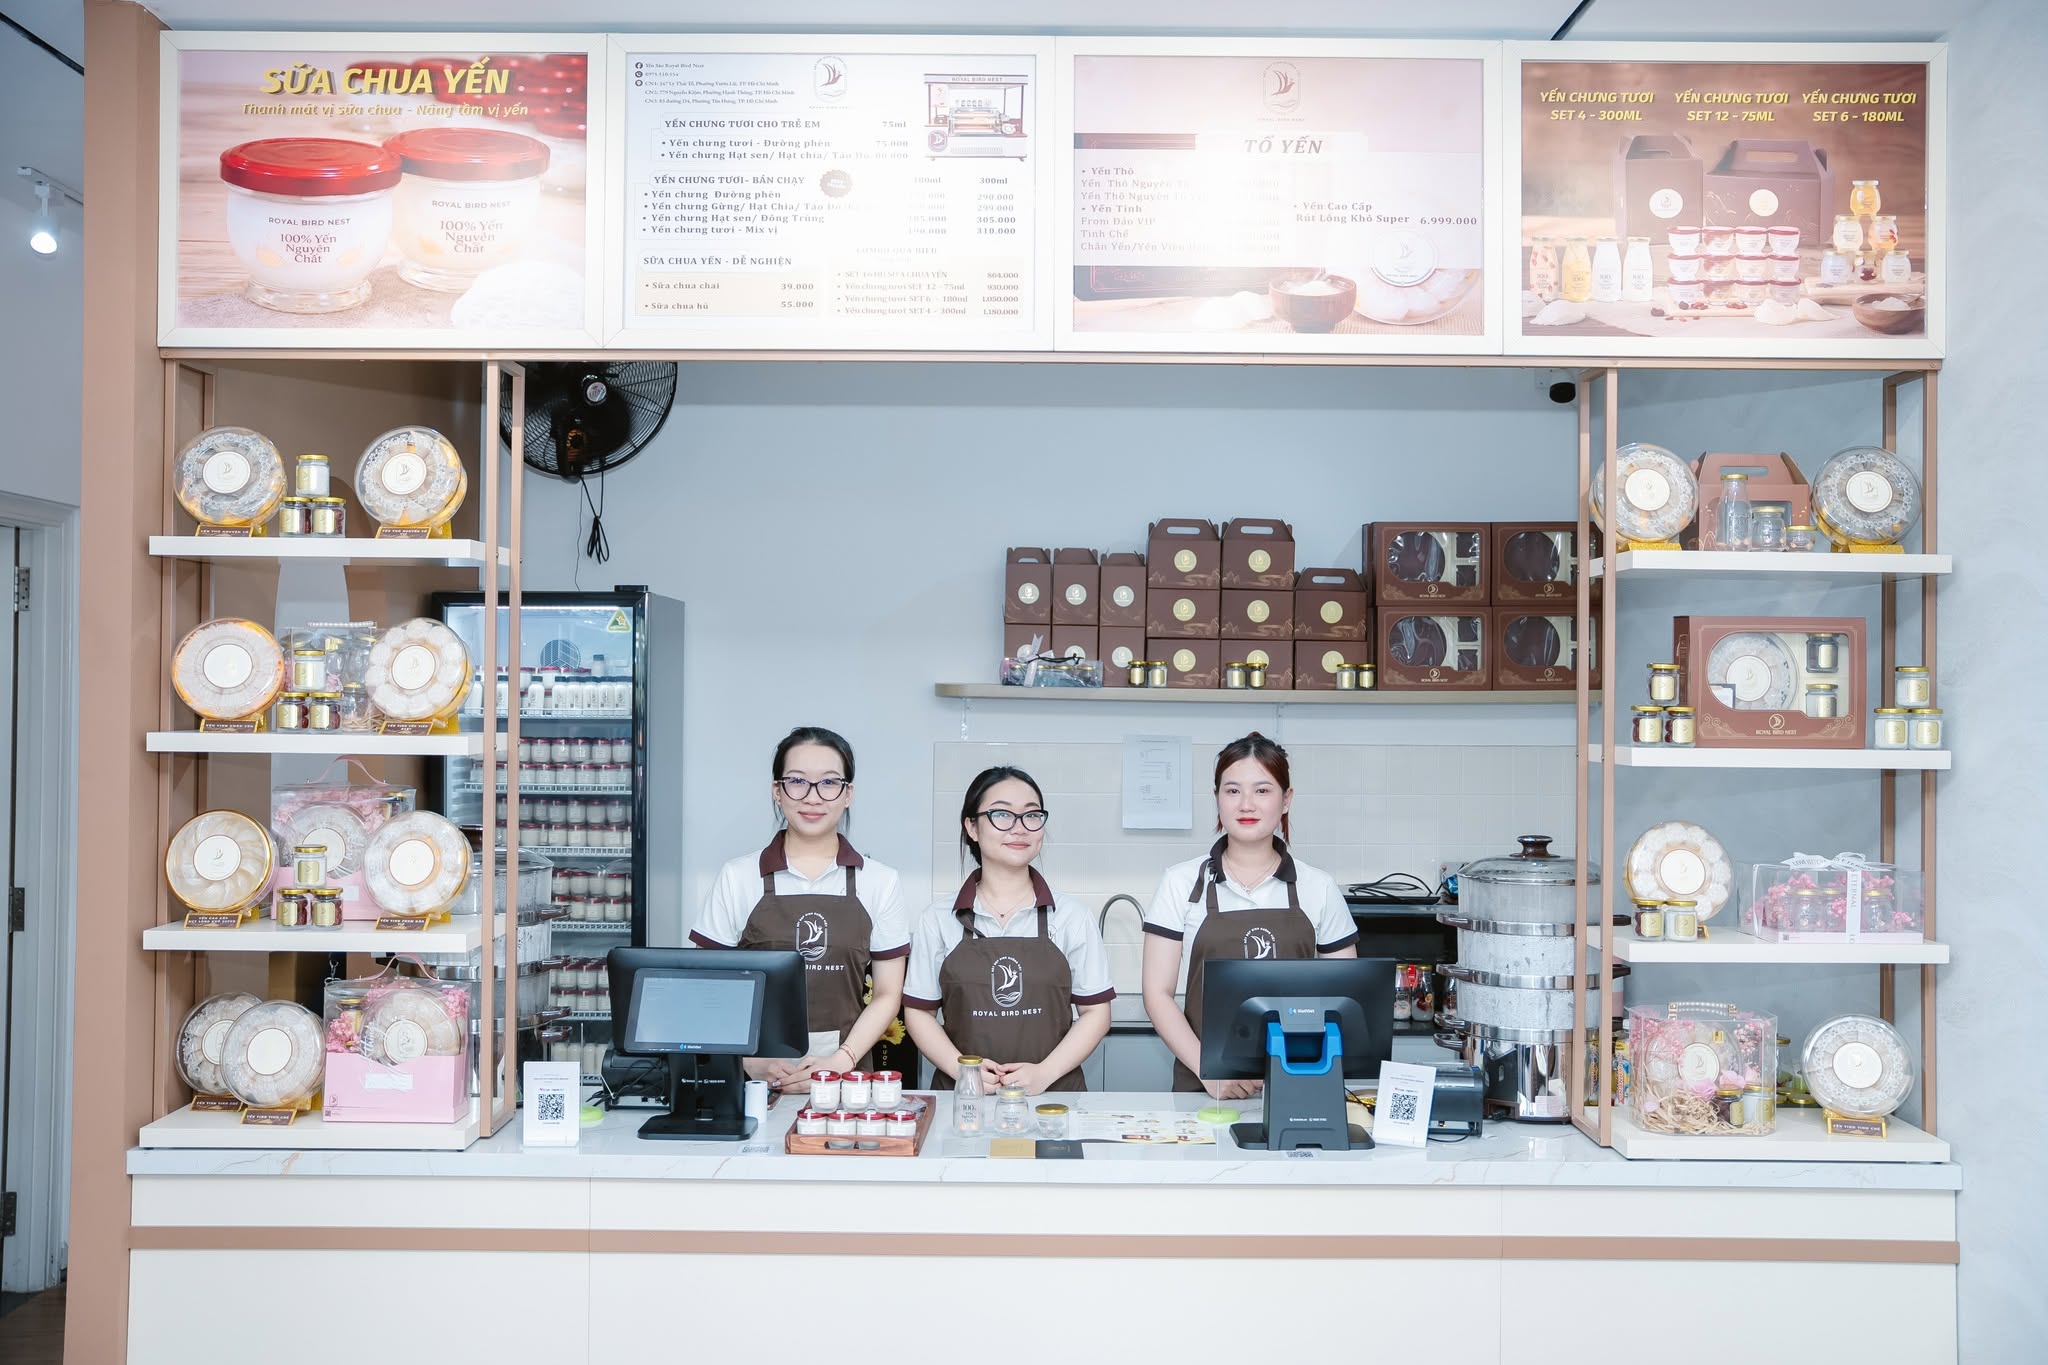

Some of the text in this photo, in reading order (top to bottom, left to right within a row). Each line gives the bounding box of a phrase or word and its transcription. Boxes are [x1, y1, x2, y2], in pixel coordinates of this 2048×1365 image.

[260, 56, 511, 95] SỮA CHUA YẾN
[1539, 87, 1655, 103] YẾN CHƯNG TƯƠI
[1674, 88, 1789, 104] YẾN CHƯNG TƯƠI
[1801, 88, 1917, 104] YẾN CHƯNG TƯƠI
[243, 103, 287, 116] Thanh
[290, 103, 318, 116] mát
[322, 103, 335, 118] vị
[367, 103, 403, 116] chua
[457, 101, 484, 116] tầm
[488, 103, 500, 118] vị
[503, 101, 529, 118] yến
[1550, 109, 1576, 121] SET
[1577, 109, 1587, 121] 4
[1598, 109, 1643, 121] 300ML
[1686, 110, 1712, 122] SET
[1714, 110, 1729, 122] 12
[1741, 110, 1776, 122] 75ML
[1812, 111, 1839, 122] SET
[1840, 111, 1849, 122] 6
[1862, 111, 1905, 122] 180ML
[664, 117, 685, 128] YẾN
[688, 119, 726, 128] CHƯNG
[729, 119, 754, 128] TƯƠI
[756, 119, 778, 128] CHO
[804, 119, 821, 128] EM
[882, 120, 907, 129] 75ml
[669, 138, 689, 148] Yến
[692, 139, 726, 150] chưng
[729, 139, 753, 148] tươi
[763, 138, 801, 150] Đường
[1281, 135, 1323, 154] YẾN
[668, 150, 828, 162] Yến chưng Hạt sen/ Hạt chia/
[1090, 167, 1134, 175] Yến Thô
[654, 174, 676, 184] YẾN
[678, 176, 715, 184] CHƯNG
[752, 174, 775, 184] BÁN
[777, 176, 805, 186] CHẠY
[979, 177, 1008, 185] 300ml
[1080, 179, 1101, 188] Yến
[651, 190, 671, 198] Yến
[674, 191, 709, 200] chưng
[713, 190, 752, 200] Đường
[1080, 192, 1101, 200] Yến
[431, 200, 511, 209] ROYAL BIRD NEST
[651, 202, 671, 210] Yến
[674, 202, 708, 211] chưng
[711, 202, 746, 212] Gừng/
[749, 202, 768, 212] Hạt
[770, 202, 800, 211] Chia/
[1090, 205, 1142, 213] Yến Tinh
[1302, 202, 1373, 212] Yến Cao Cấp
[268, 216, 352, 226] ROYAL BIRD NEST
[651, 214, 671, 222] Yến
[674, 214, 708, 223] chưng
[711, 214, 730, 223] Hạt
[733, 214, 757, 222] sen/
[760, 214, 789, 223] Đông
[976, 216, 1016, 224] 305.000
[1080, 217, 1109, 225] From
[1319, 214, 1347, 224] Lông
[1350, 214, 1373, 223] Khô
[1376, 214, 1410, 225] Super
[1419, 216, 1477, 225] 6.999.000
[440, 219, 477, 232] 100%
[651, 225, 778, 235] Yến chưng tươi Mix vị
[976, 227, 1016, 235] 310.000
[280, 232, 337, 244] 100% Yến
[285, 243, 331, 255] Nguyên
[294, 252, 323, 264] Chất
[668, 257, 697, 265] CHUA
[701, 255, 722, 265] YẾN
[750, 257, 792, 267] NGHIỆN
[652, 281, 720, 290] Sữa chua chai
[650, 302, 694, 310] Sữa chua
[1022, 1008, 1042, 1016] NEST
